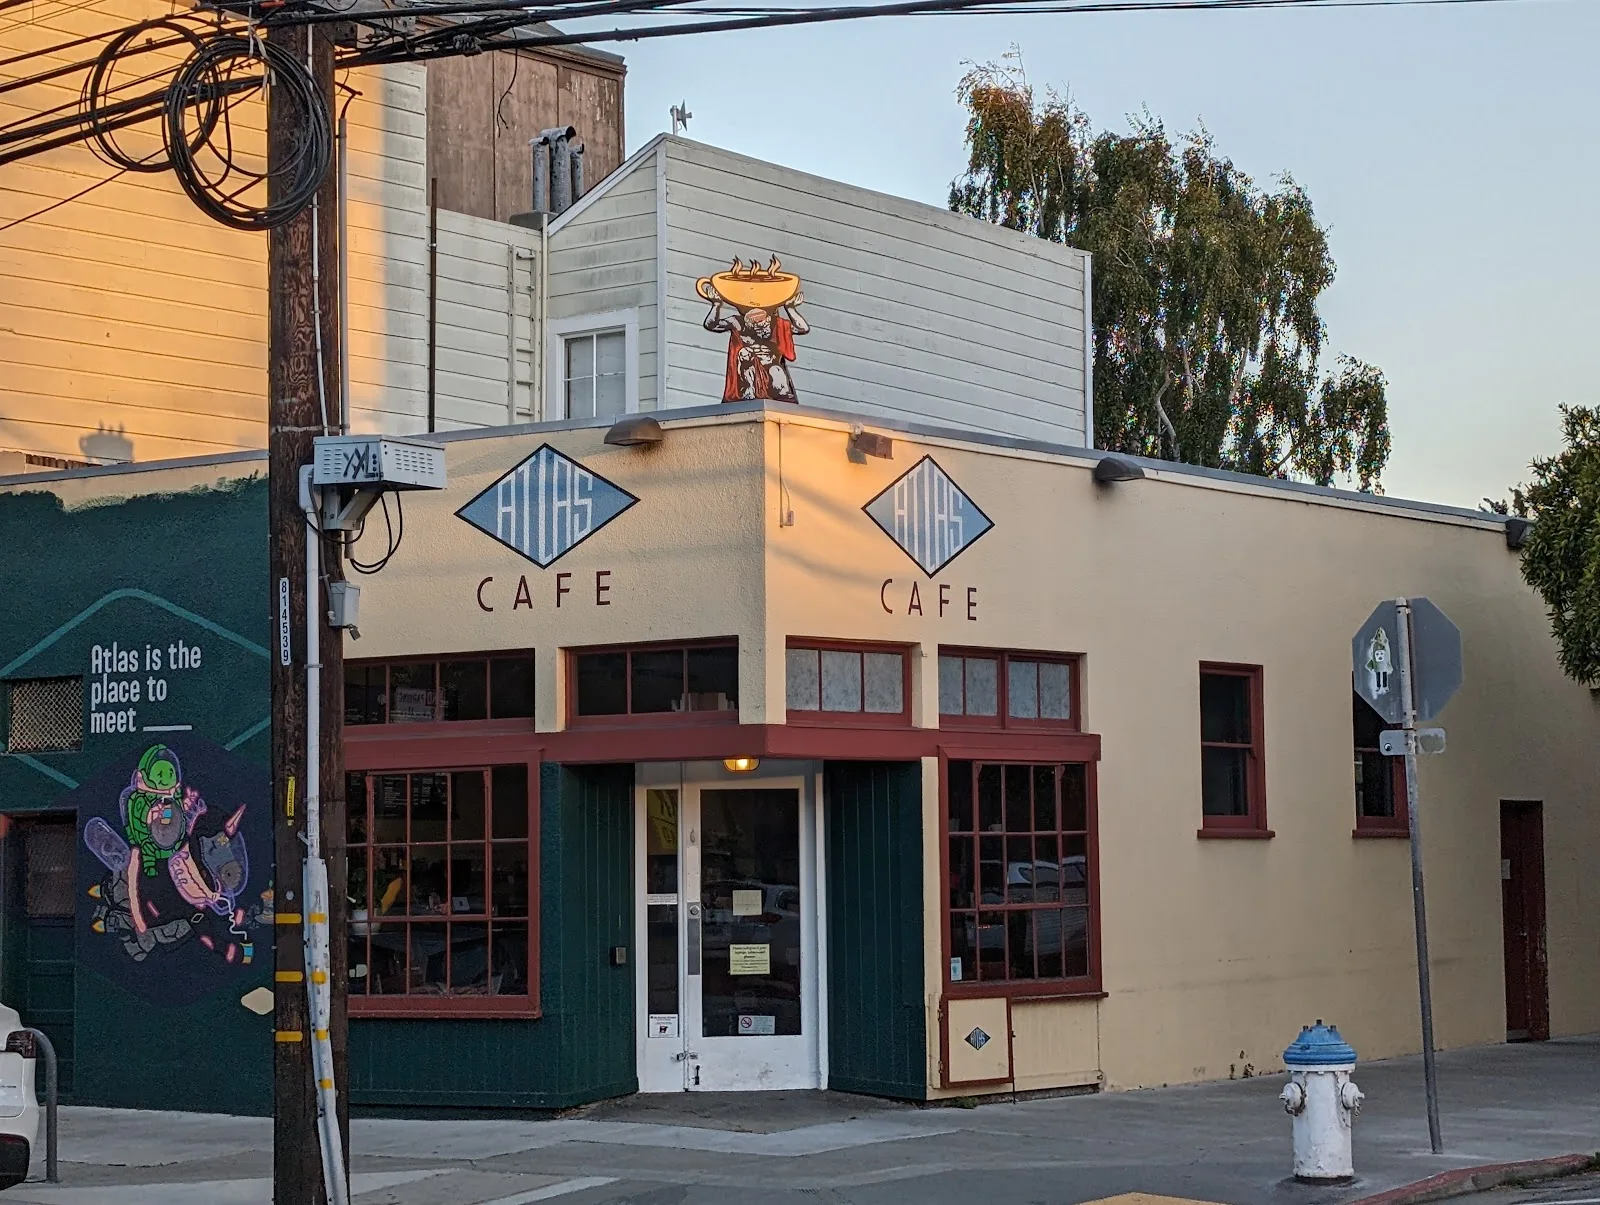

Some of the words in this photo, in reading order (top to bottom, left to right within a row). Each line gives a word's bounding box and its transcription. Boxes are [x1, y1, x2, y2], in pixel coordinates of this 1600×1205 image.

[497, 448, 593, 566] ATLAS
[894, 458, 963, 574] ATLAS
[476, 570, 611, 613] CAFE
[880, 578, 977, 621] CAFE
[281, 581, 289, 662] 814539
[91, 641, 139, 674] Atlas
[145, 644, 162, 671] is
[168, 639, 202, 670] the
[91, 673, 140, 711] place
[147, 676, 167, 702] to
[90, 707, 137, 734] meet
